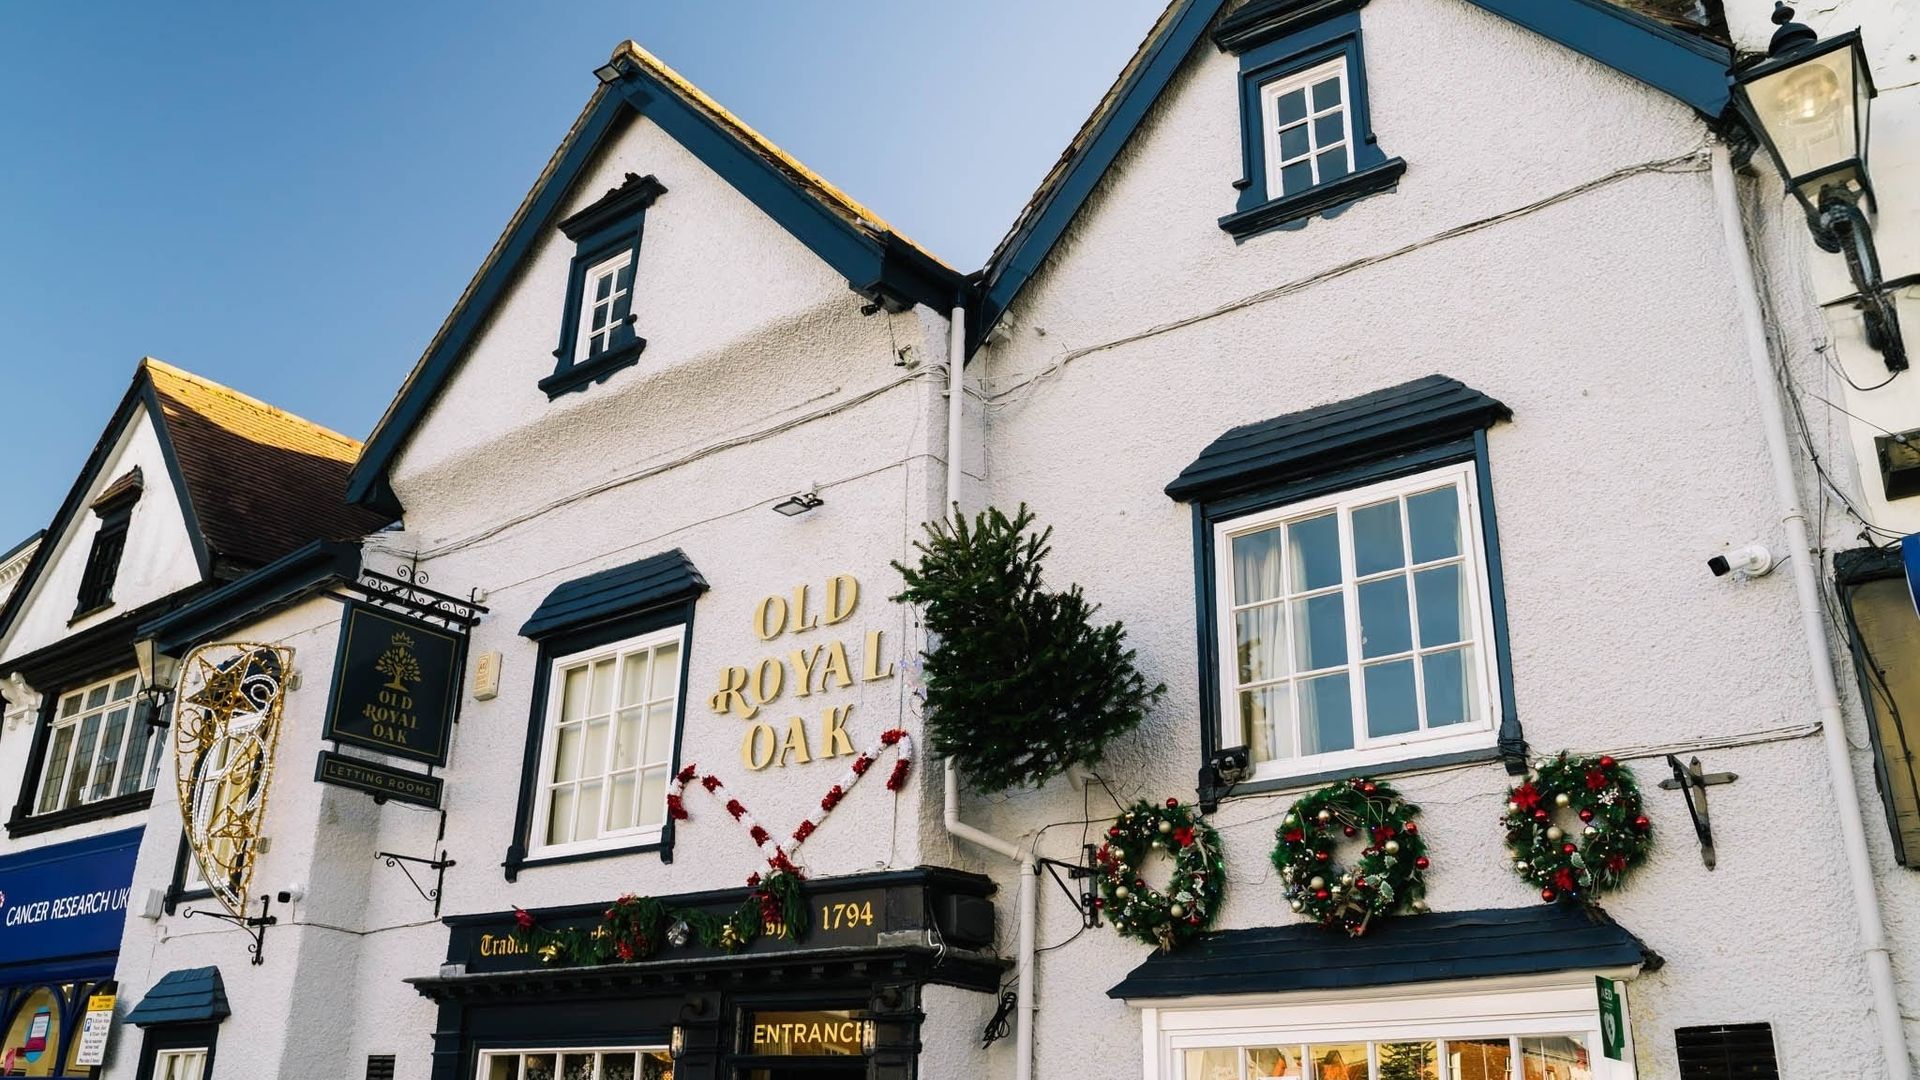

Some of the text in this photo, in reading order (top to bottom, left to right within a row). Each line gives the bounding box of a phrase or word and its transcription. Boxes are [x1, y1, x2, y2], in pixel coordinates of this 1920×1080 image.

[754, 573, 860, 641] OLD
[707, 630, 895, 720] ROYAL
[379, 690, 413, 710] OLD
[362, 703, 420, 731] ROYAL
[372, 723, 408, 745] OAK
[741, 703, 855, 771] OAK
[329, 762, 432, 797] LETTING ROOMS
[6, 886, 131, 927] CANCER RESEARCH UK
[821, 901, 874, 930] 1794
[1600, 987, 1613, 1001] AED
